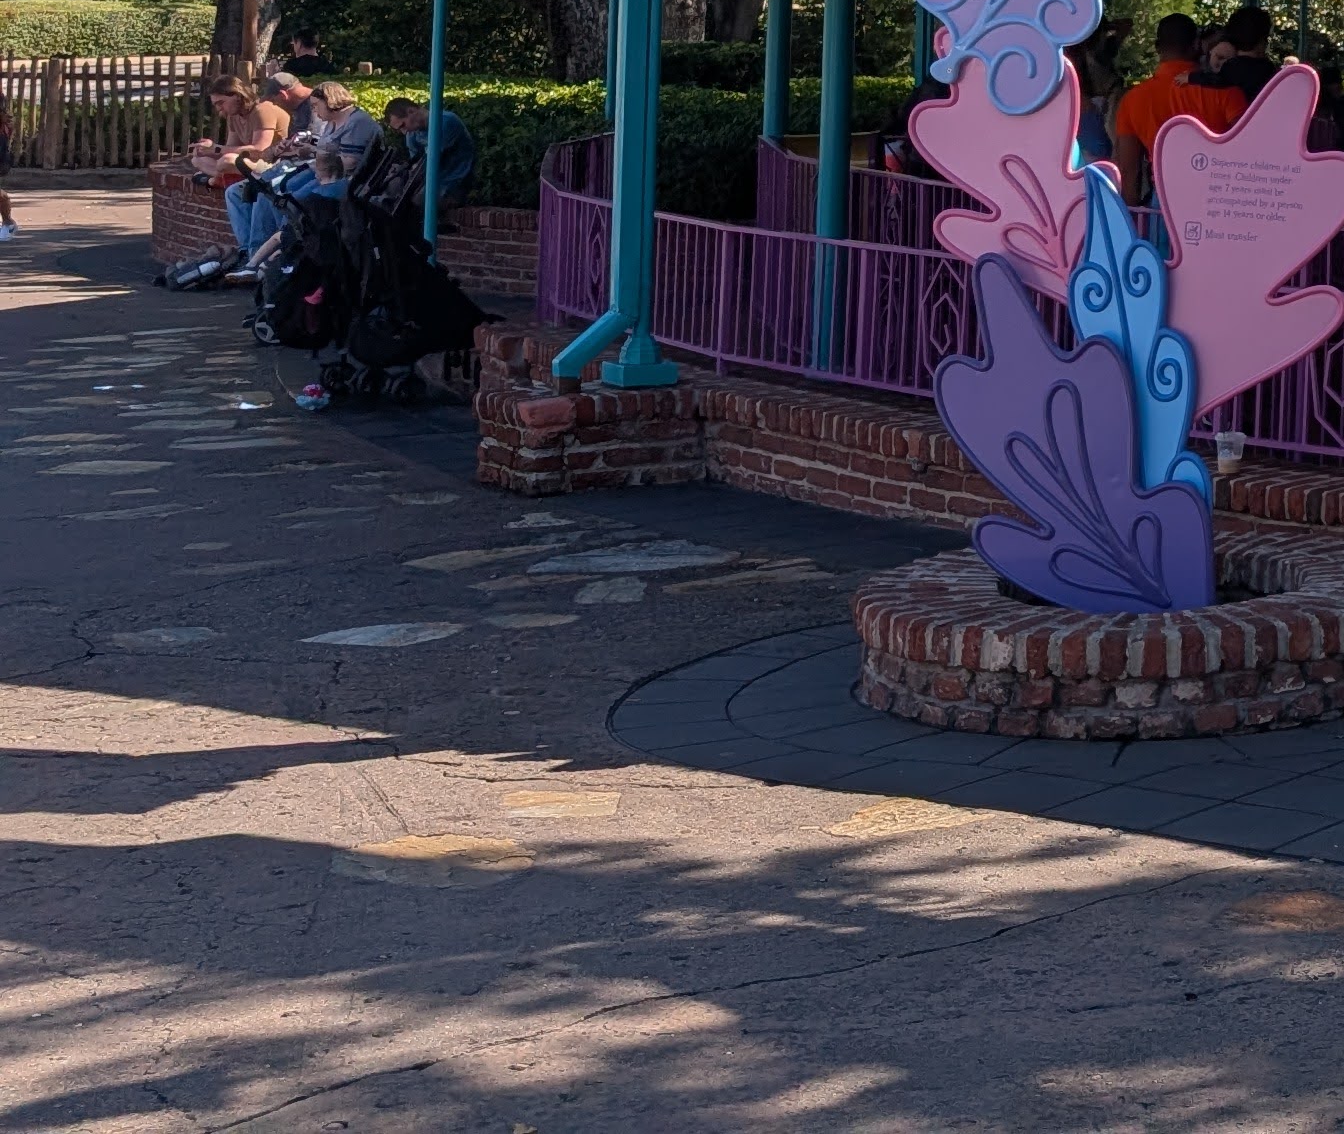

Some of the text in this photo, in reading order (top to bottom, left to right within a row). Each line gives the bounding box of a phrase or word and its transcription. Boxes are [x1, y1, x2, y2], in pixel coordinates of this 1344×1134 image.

[1211, 158, 1248, 168] Supervise
[1250, 160, 1281, 170] children
[1235, 172, 1268, 183] Children
[1270, 175, 1293, 184] under
[1208, 183, 1285, 196] age 7 years must be
[1207, 197, 1257, 207] accompanied
[1259, 198, 1269, 209] by
[1277, 201, 1303, 210] person
[1206, 209, 1220, 218] age
[1223, 209, 1231, 217] 14
[1232, 210, 1254, 219] years
[1205, 229, 1259, 241] Must transfer
